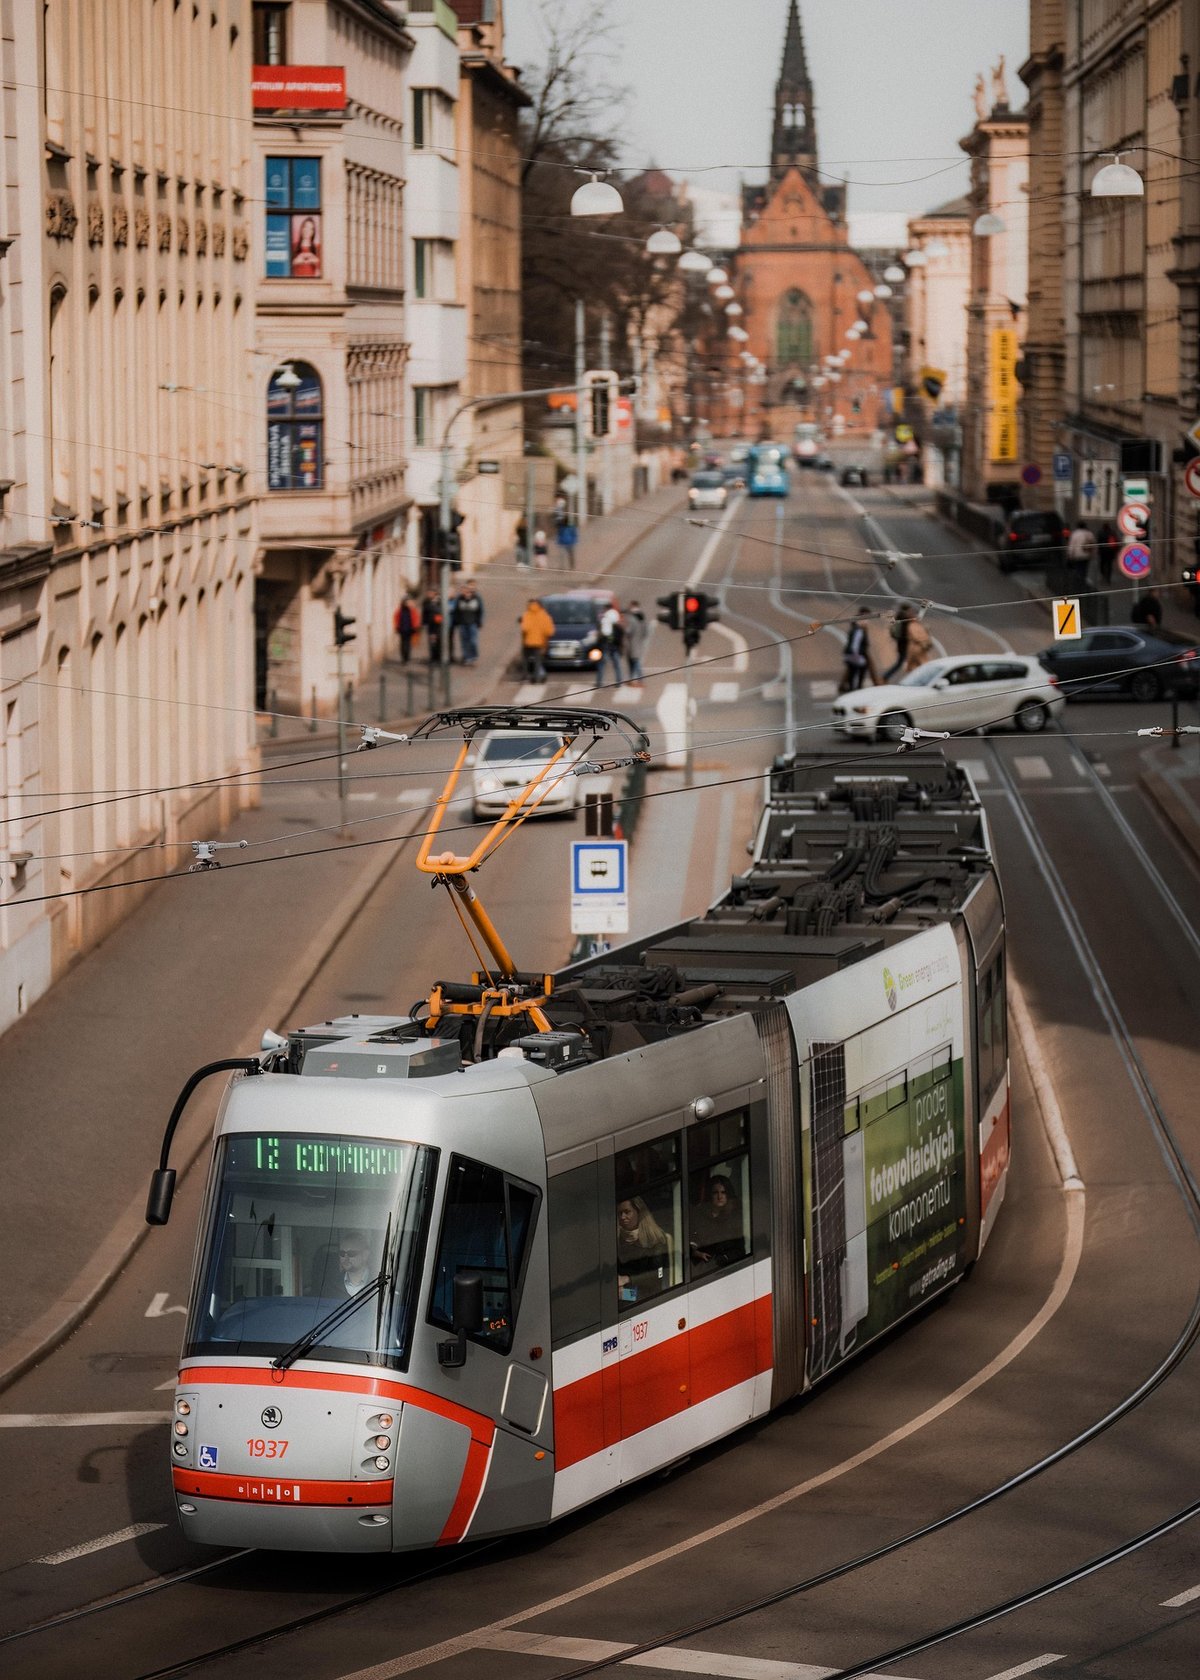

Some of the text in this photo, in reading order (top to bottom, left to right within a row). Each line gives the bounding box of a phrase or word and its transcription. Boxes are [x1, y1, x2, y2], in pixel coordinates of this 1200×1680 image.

[916, 1074, 948, 1135] prodej
[870, 1121, 955, 1205] fotovoltaických
[889, 1167, 951, 1242] komponentů
[632, 1321, 649, 1342] 1937
[246, 1438, 289, 1459] 1937
